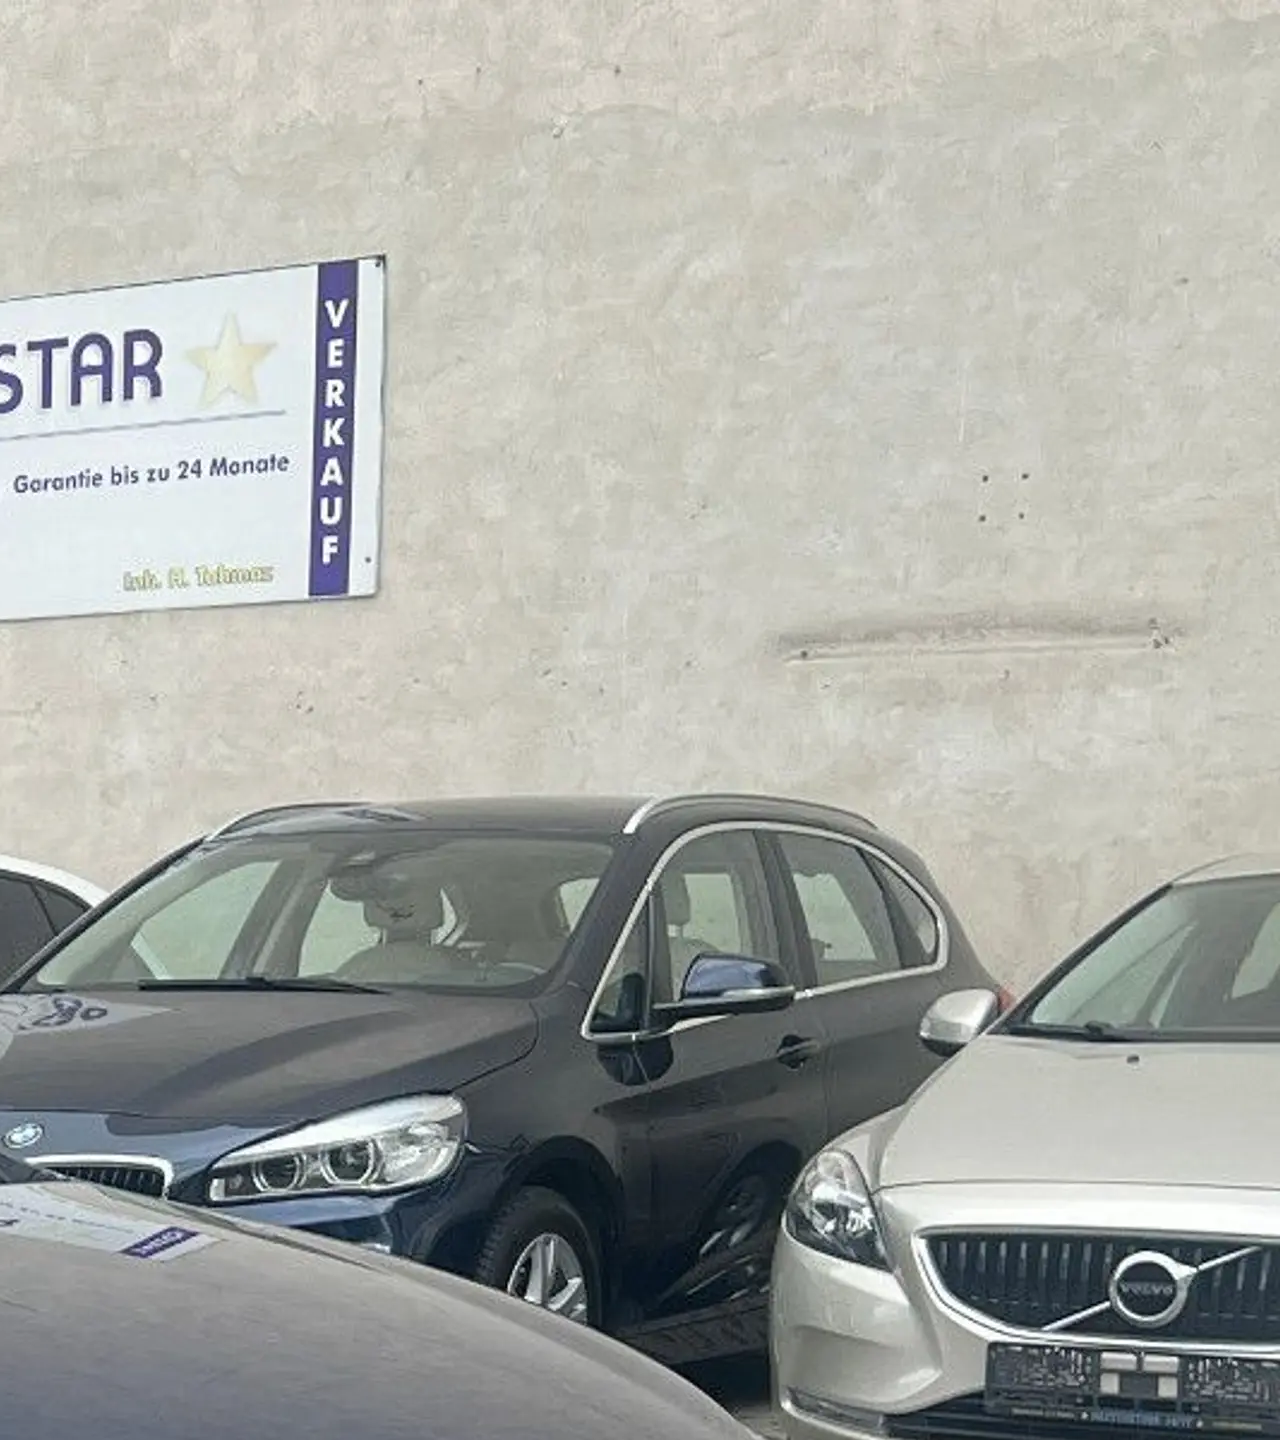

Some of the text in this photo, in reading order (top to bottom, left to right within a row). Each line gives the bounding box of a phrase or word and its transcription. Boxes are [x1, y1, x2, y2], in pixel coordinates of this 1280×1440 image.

[320, 300, 349, 564] VERKAUF
[13, 468, 103, 494] Garantie
[111, 465, 139, 485] bis
[147, 467, 170, 483] zu
[178, 460, 202, 480] 24
[210, 453, 290, 477] Monate
[1119, 1281, 1173, 1296] VOLVO
